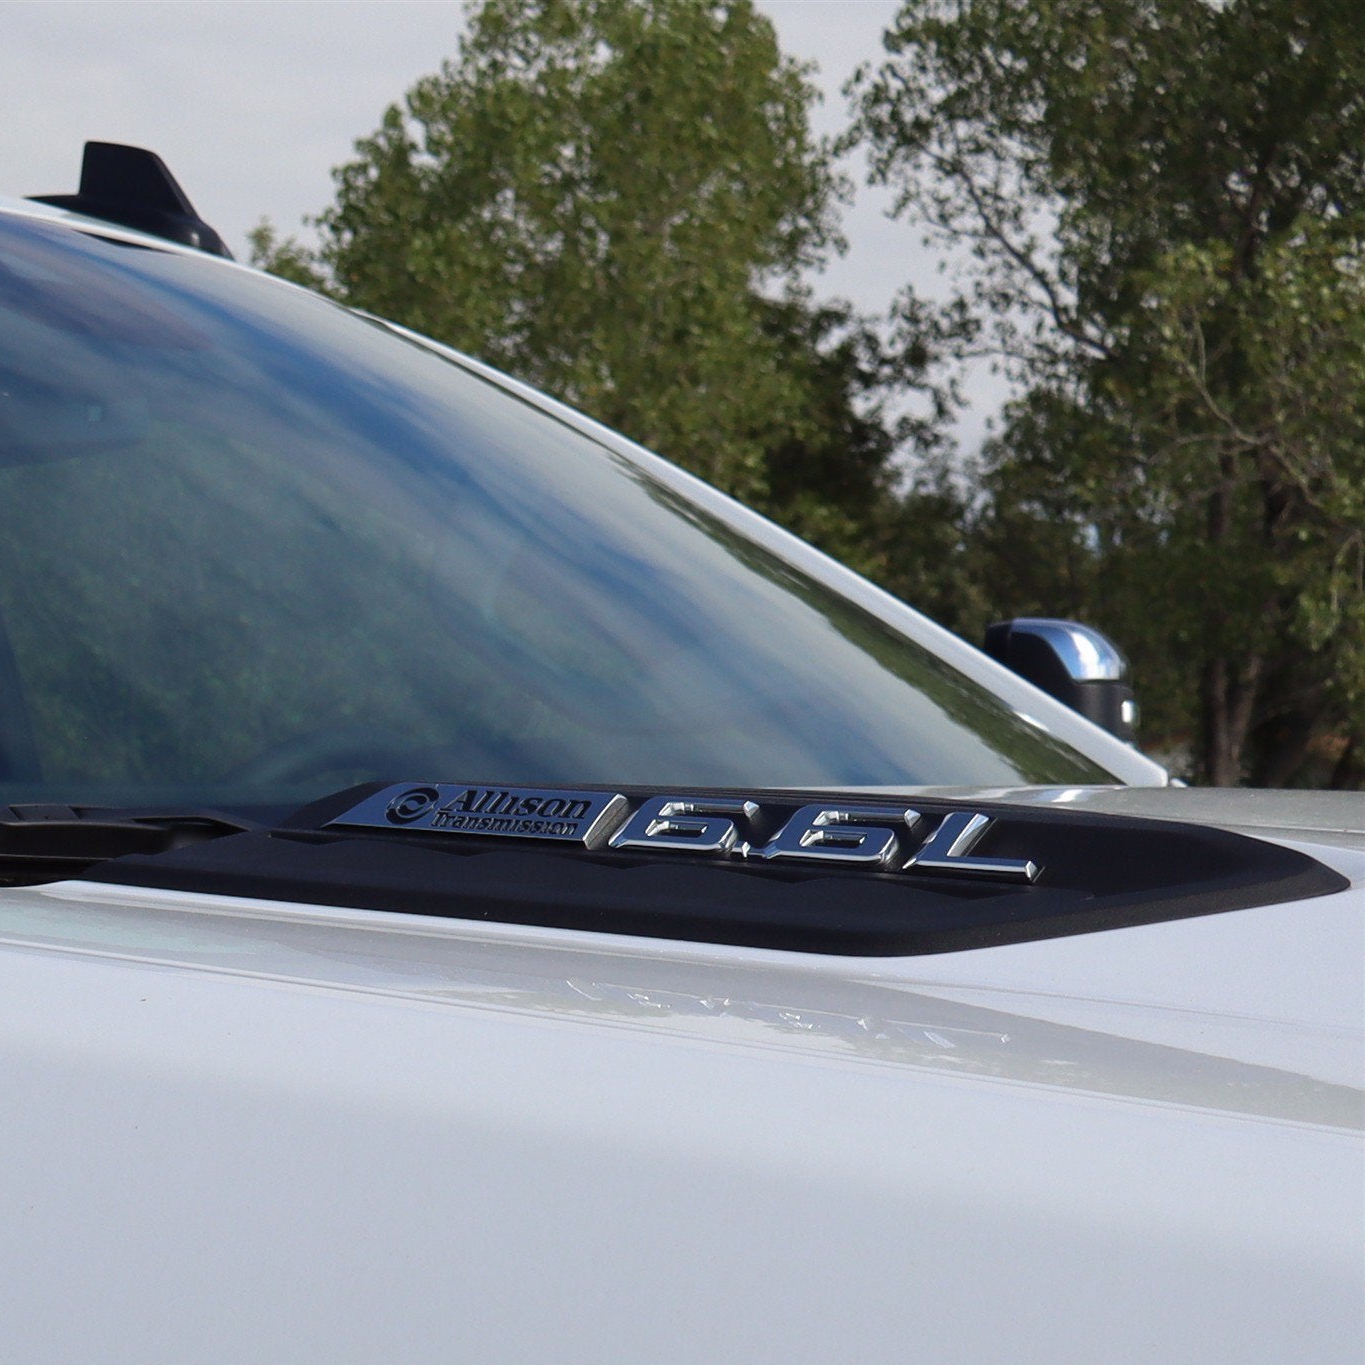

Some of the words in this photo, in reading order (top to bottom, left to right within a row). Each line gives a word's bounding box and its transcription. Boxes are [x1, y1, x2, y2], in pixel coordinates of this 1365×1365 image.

[438, 789, 592, 820] Allison
[429, 810, 579, 836] Transmission
[607, 795, 1040, 883] 6.6L
